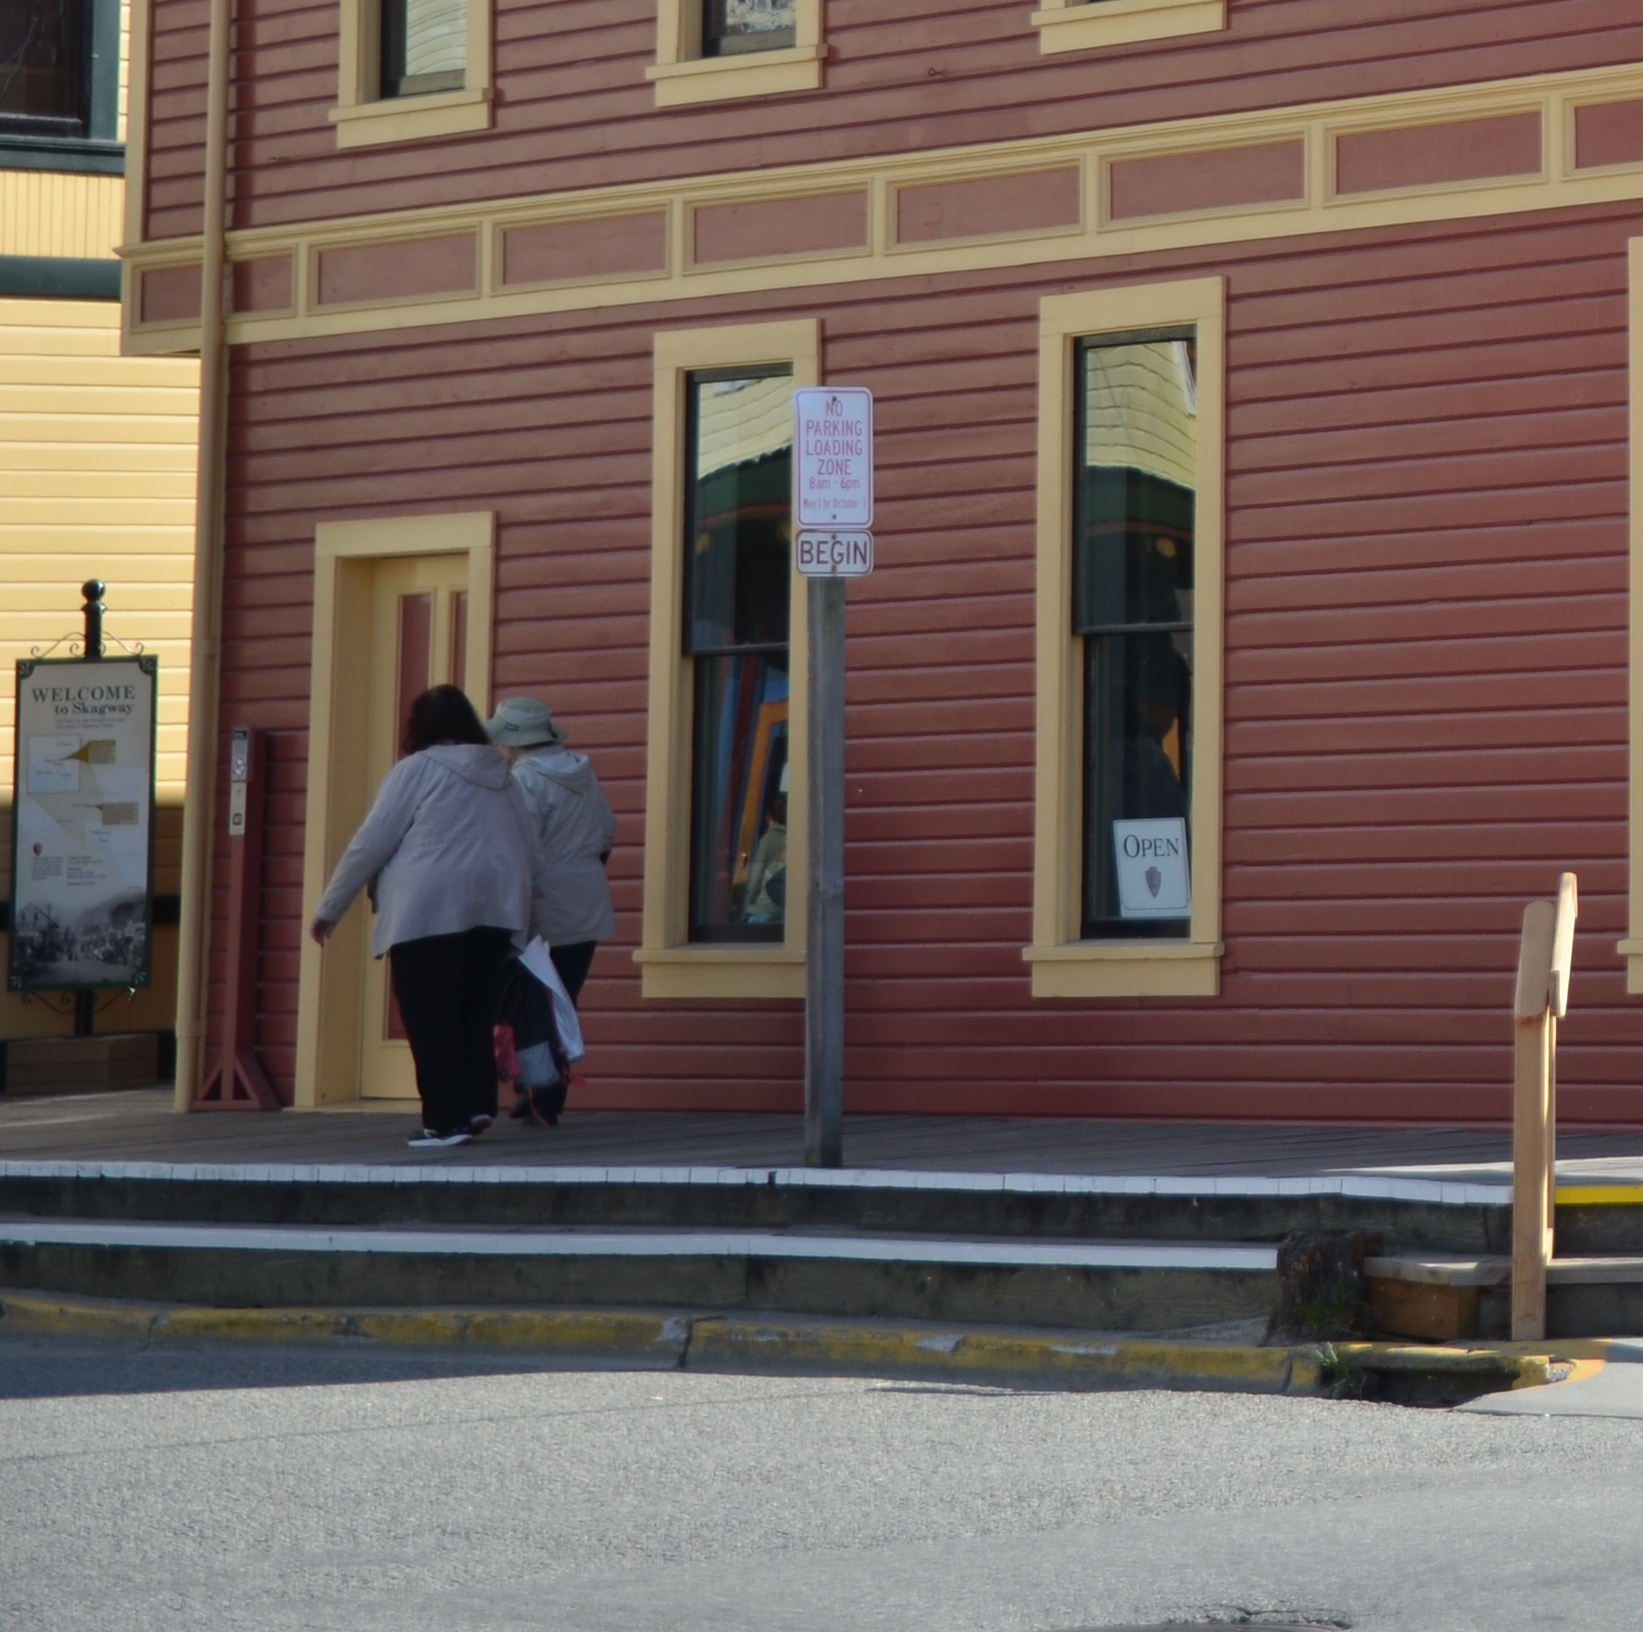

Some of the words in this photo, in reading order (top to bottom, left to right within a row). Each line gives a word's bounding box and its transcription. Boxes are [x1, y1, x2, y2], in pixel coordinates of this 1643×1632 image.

[825, 400, 844, 417] NO
[806, 420, 863, 437] PARKING
[806, 439, 863, 456] LOADING
[818, 459, 852, 476] ZONE
[809, 477, 831, 489] 8am
[840, 477, 861, 492] 6pm
[800, 540, 868, 565] BEGIN
[32, 685, 136, 703] WELCOME
[54, 705, 69, 715] to
[72, 702, 134, 715] Skagway
[1123, 834, 1180, 858] OPEN
